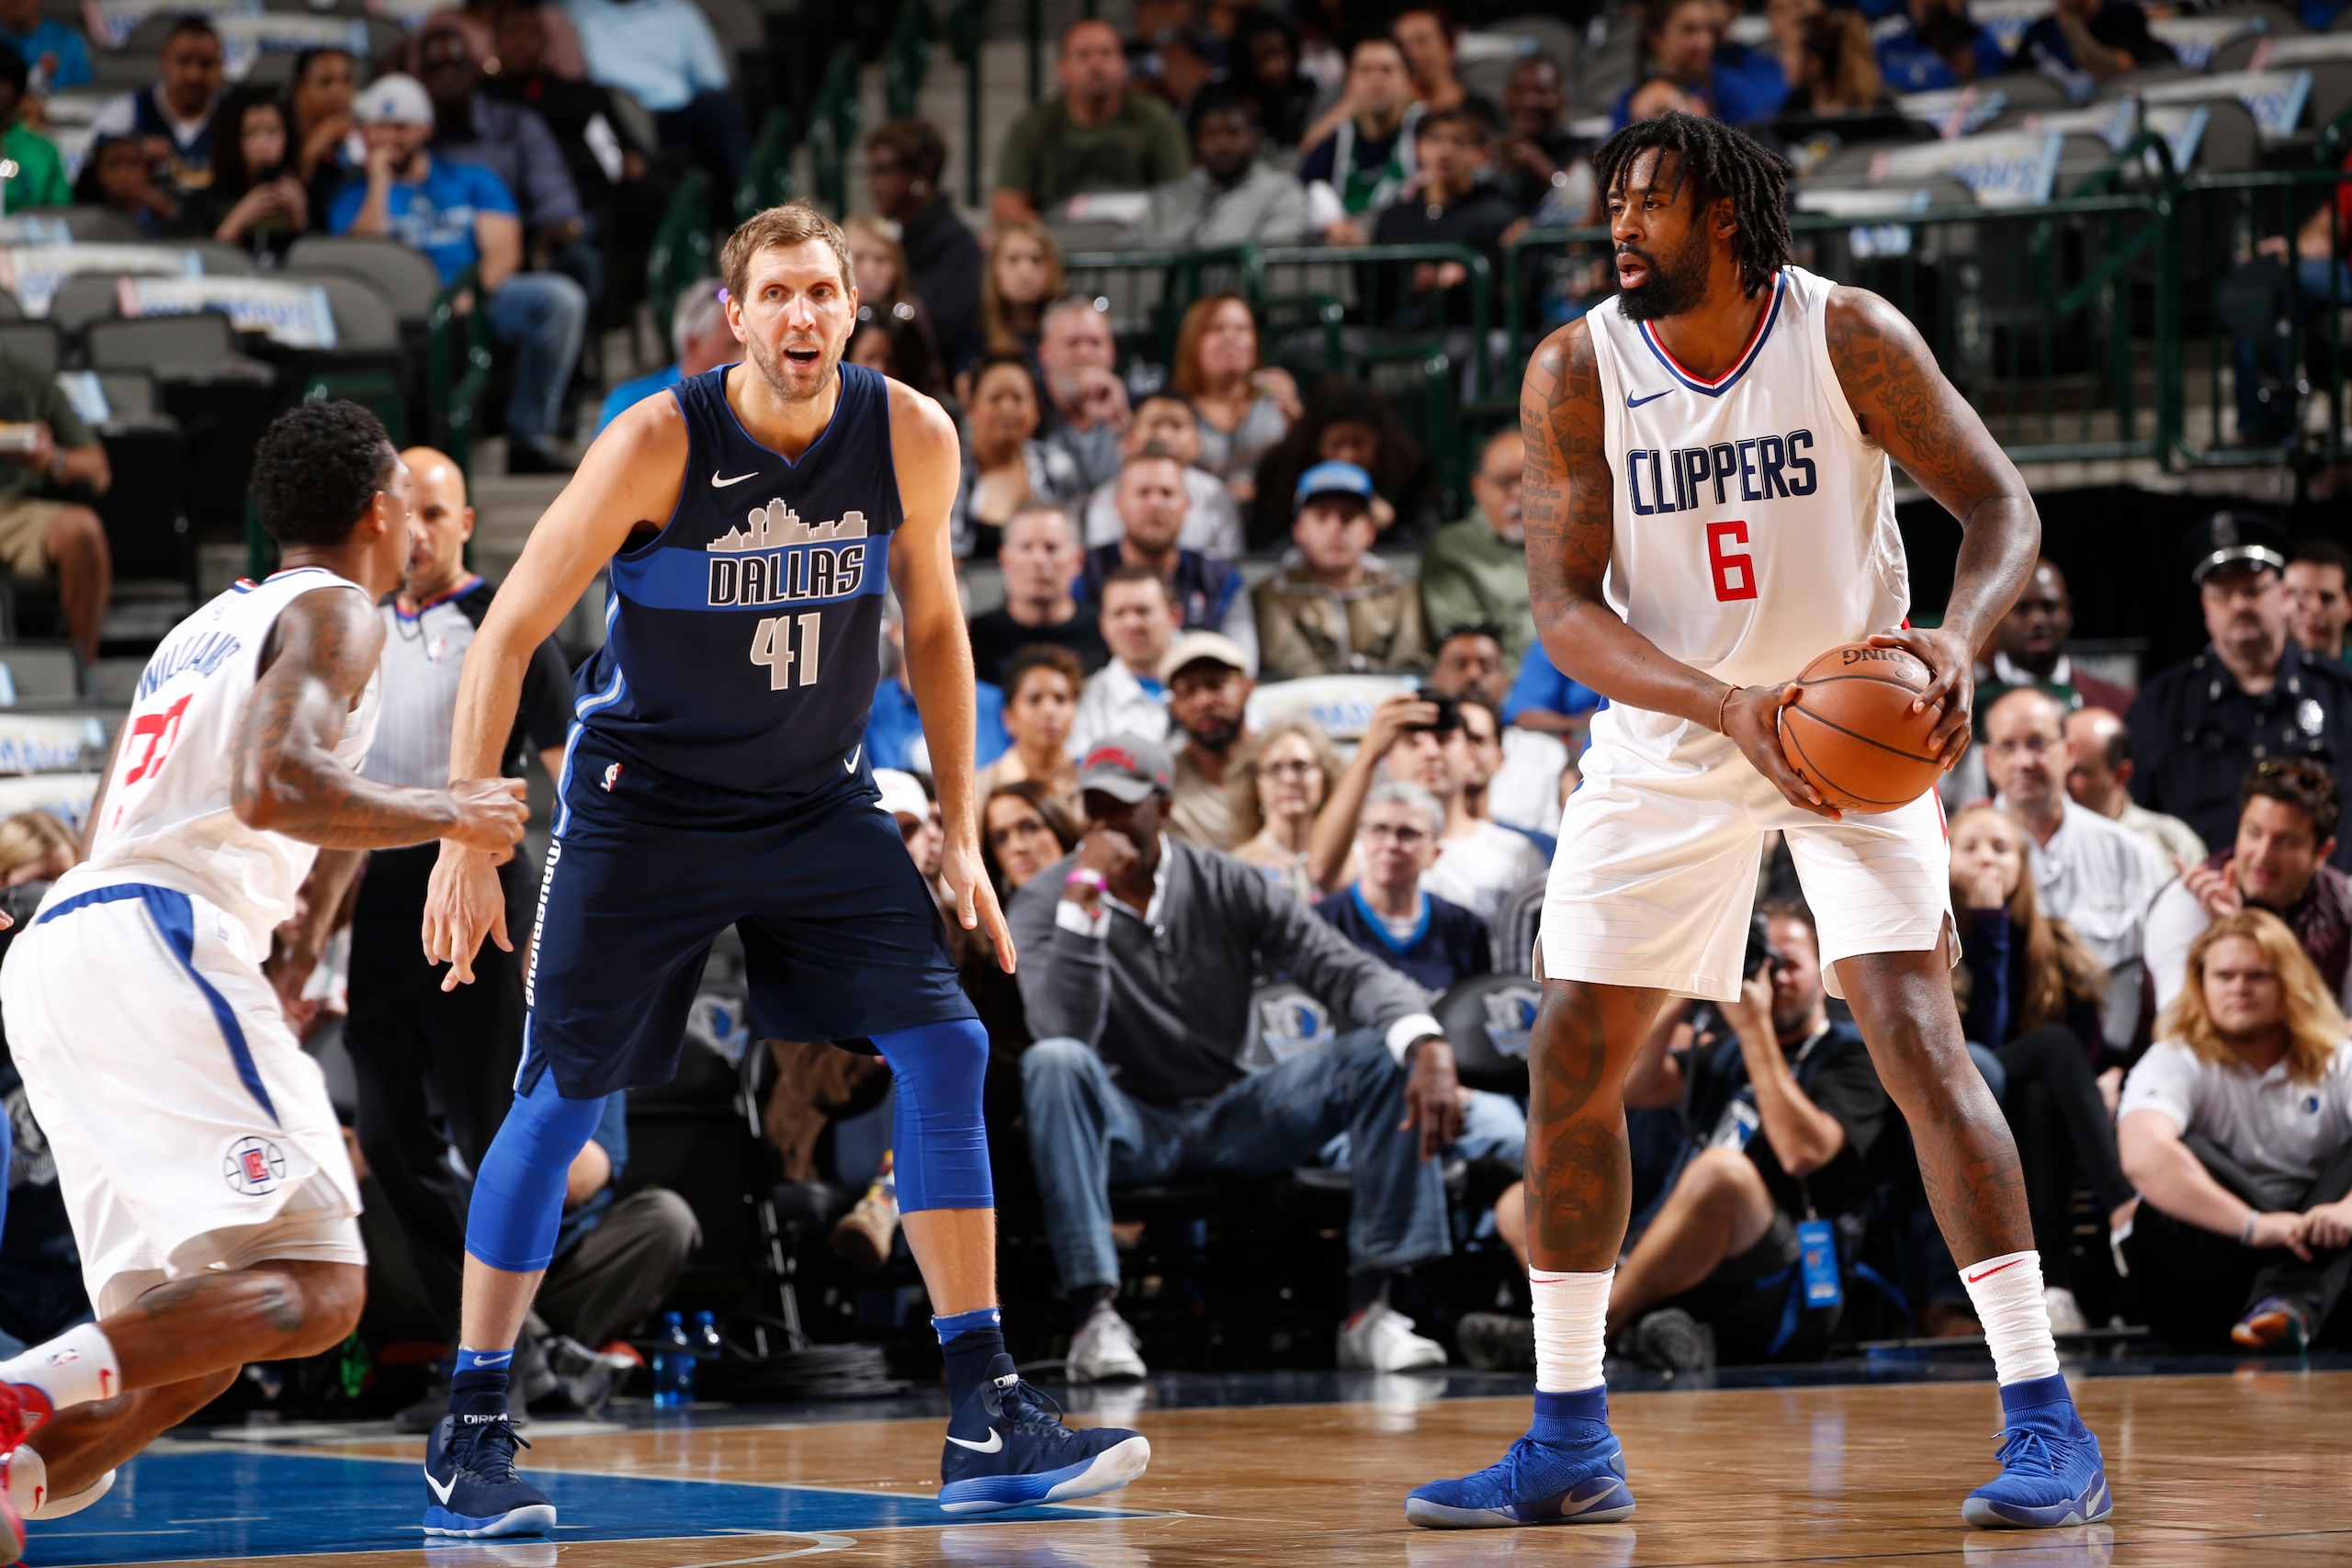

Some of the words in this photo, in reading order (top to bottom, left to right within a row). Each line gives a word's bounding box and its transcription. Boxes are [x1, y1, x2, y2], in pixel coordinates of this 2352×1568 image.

[1626, 429, 1817, 515] CLIPPERS
[707, 544, 865, 606] DALLAS
[1706, 520, 1758, 602] 6
[139, 631, 242, 702] WILLIAMS
[750, 612, 821, 691] 41
[526, 839, 562, 1007] MAVERICKS
